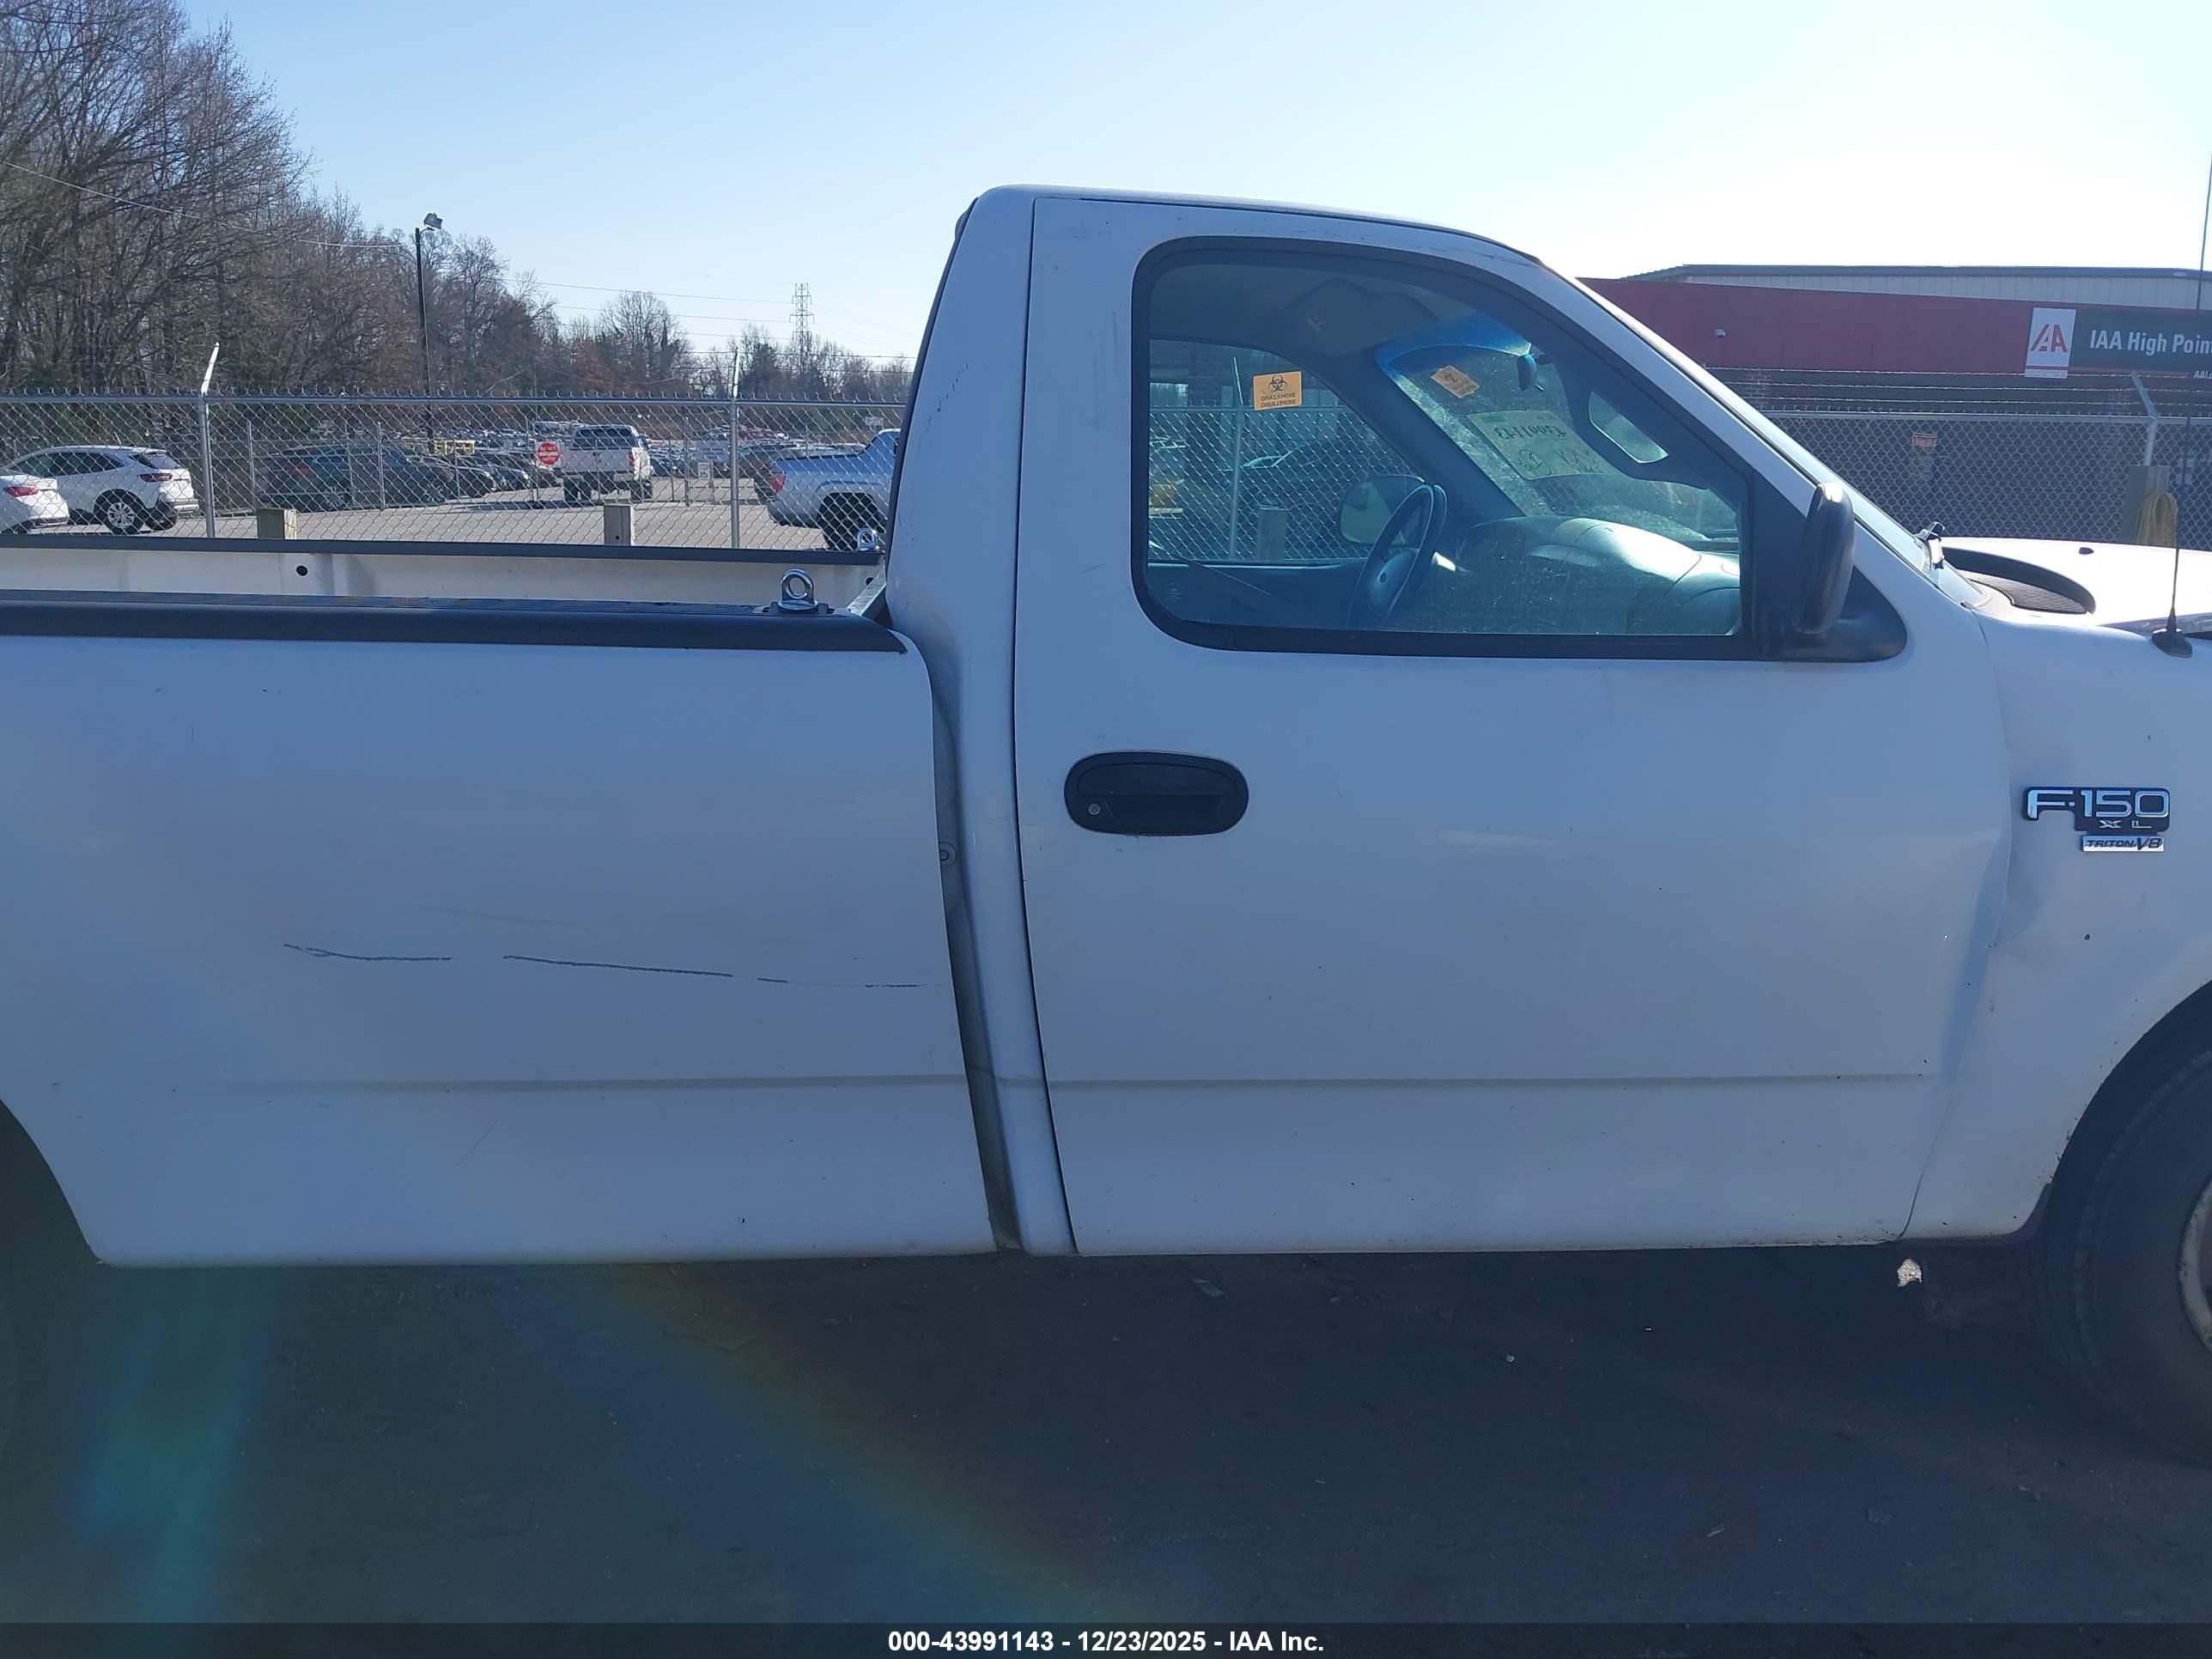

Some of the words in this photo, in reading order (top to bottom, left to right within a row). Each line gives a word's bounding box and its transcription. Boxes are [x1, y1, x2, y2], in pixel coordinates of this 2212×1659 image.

[2090, 330, 2124, 350] IAA
[2128, 331, 2167, 356] High
[2027, 789, 2169, 819] F-150
[2086, 839, 2136, 848] TRITON
[2135, 836, 2162, 850] V8
